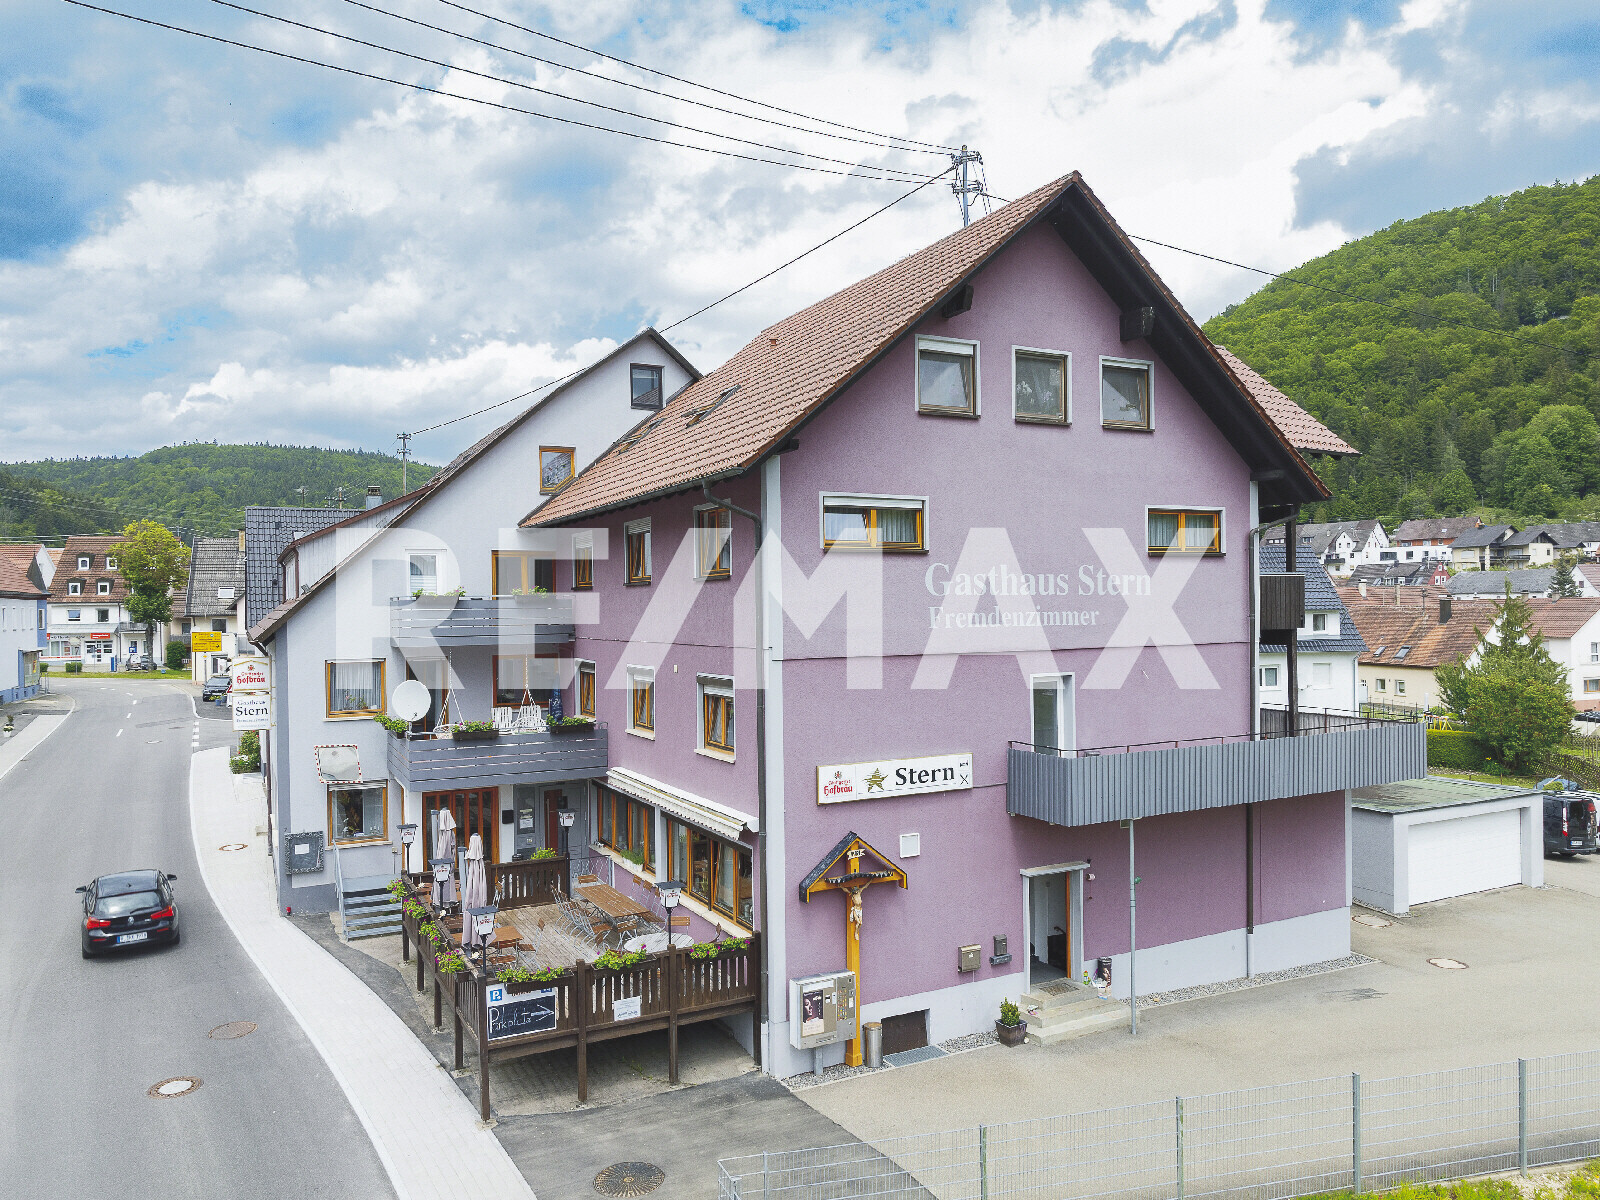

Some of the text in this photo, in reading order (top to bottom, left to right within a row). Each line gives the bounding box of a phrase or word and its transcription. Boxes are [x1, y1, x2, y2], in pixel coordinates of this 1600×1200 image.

[924, 562, 1152, 597] Gasthaus Stern
[928, 605, 1100, 629] Fremdenzimmer
[236, 675, 266, 684] Hofbräu
[235, 706, 269, 717] Stern
[895, 766, 955, 786] Stern
